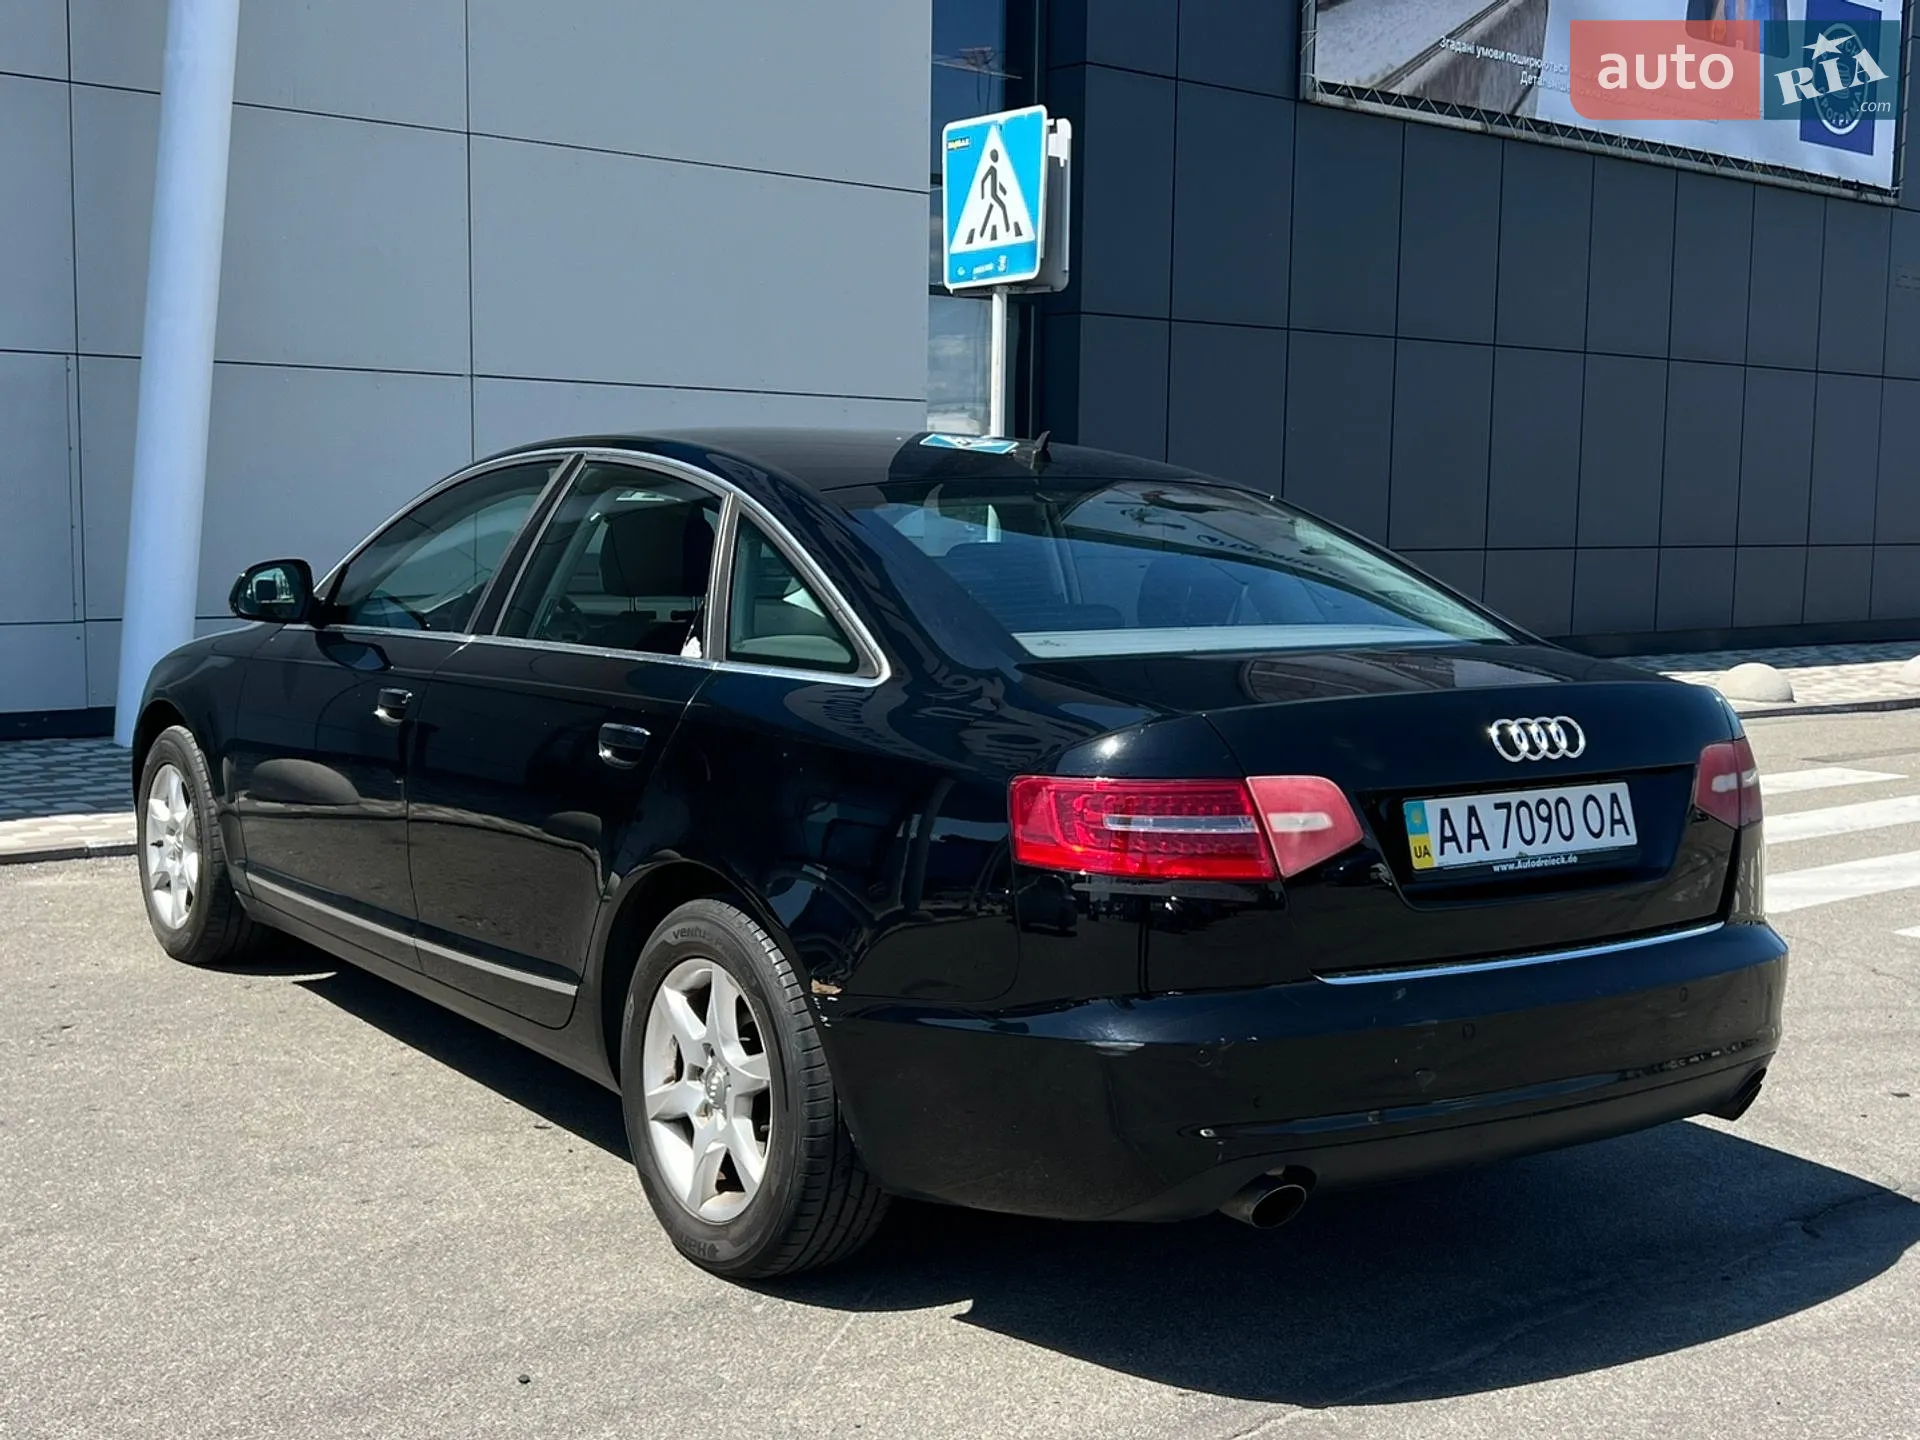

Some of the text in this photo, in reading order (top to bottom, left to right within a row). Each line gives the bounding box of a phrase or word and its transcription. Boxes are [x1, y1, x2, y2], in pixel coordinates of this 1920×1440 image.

[1439, 35, 1475, 54] Згадані
[1476, 44, 1505, 60] умови
[1439, 792, 1631, 856] AA 7090 OA
[1414, 845, 1432, 860] UA
